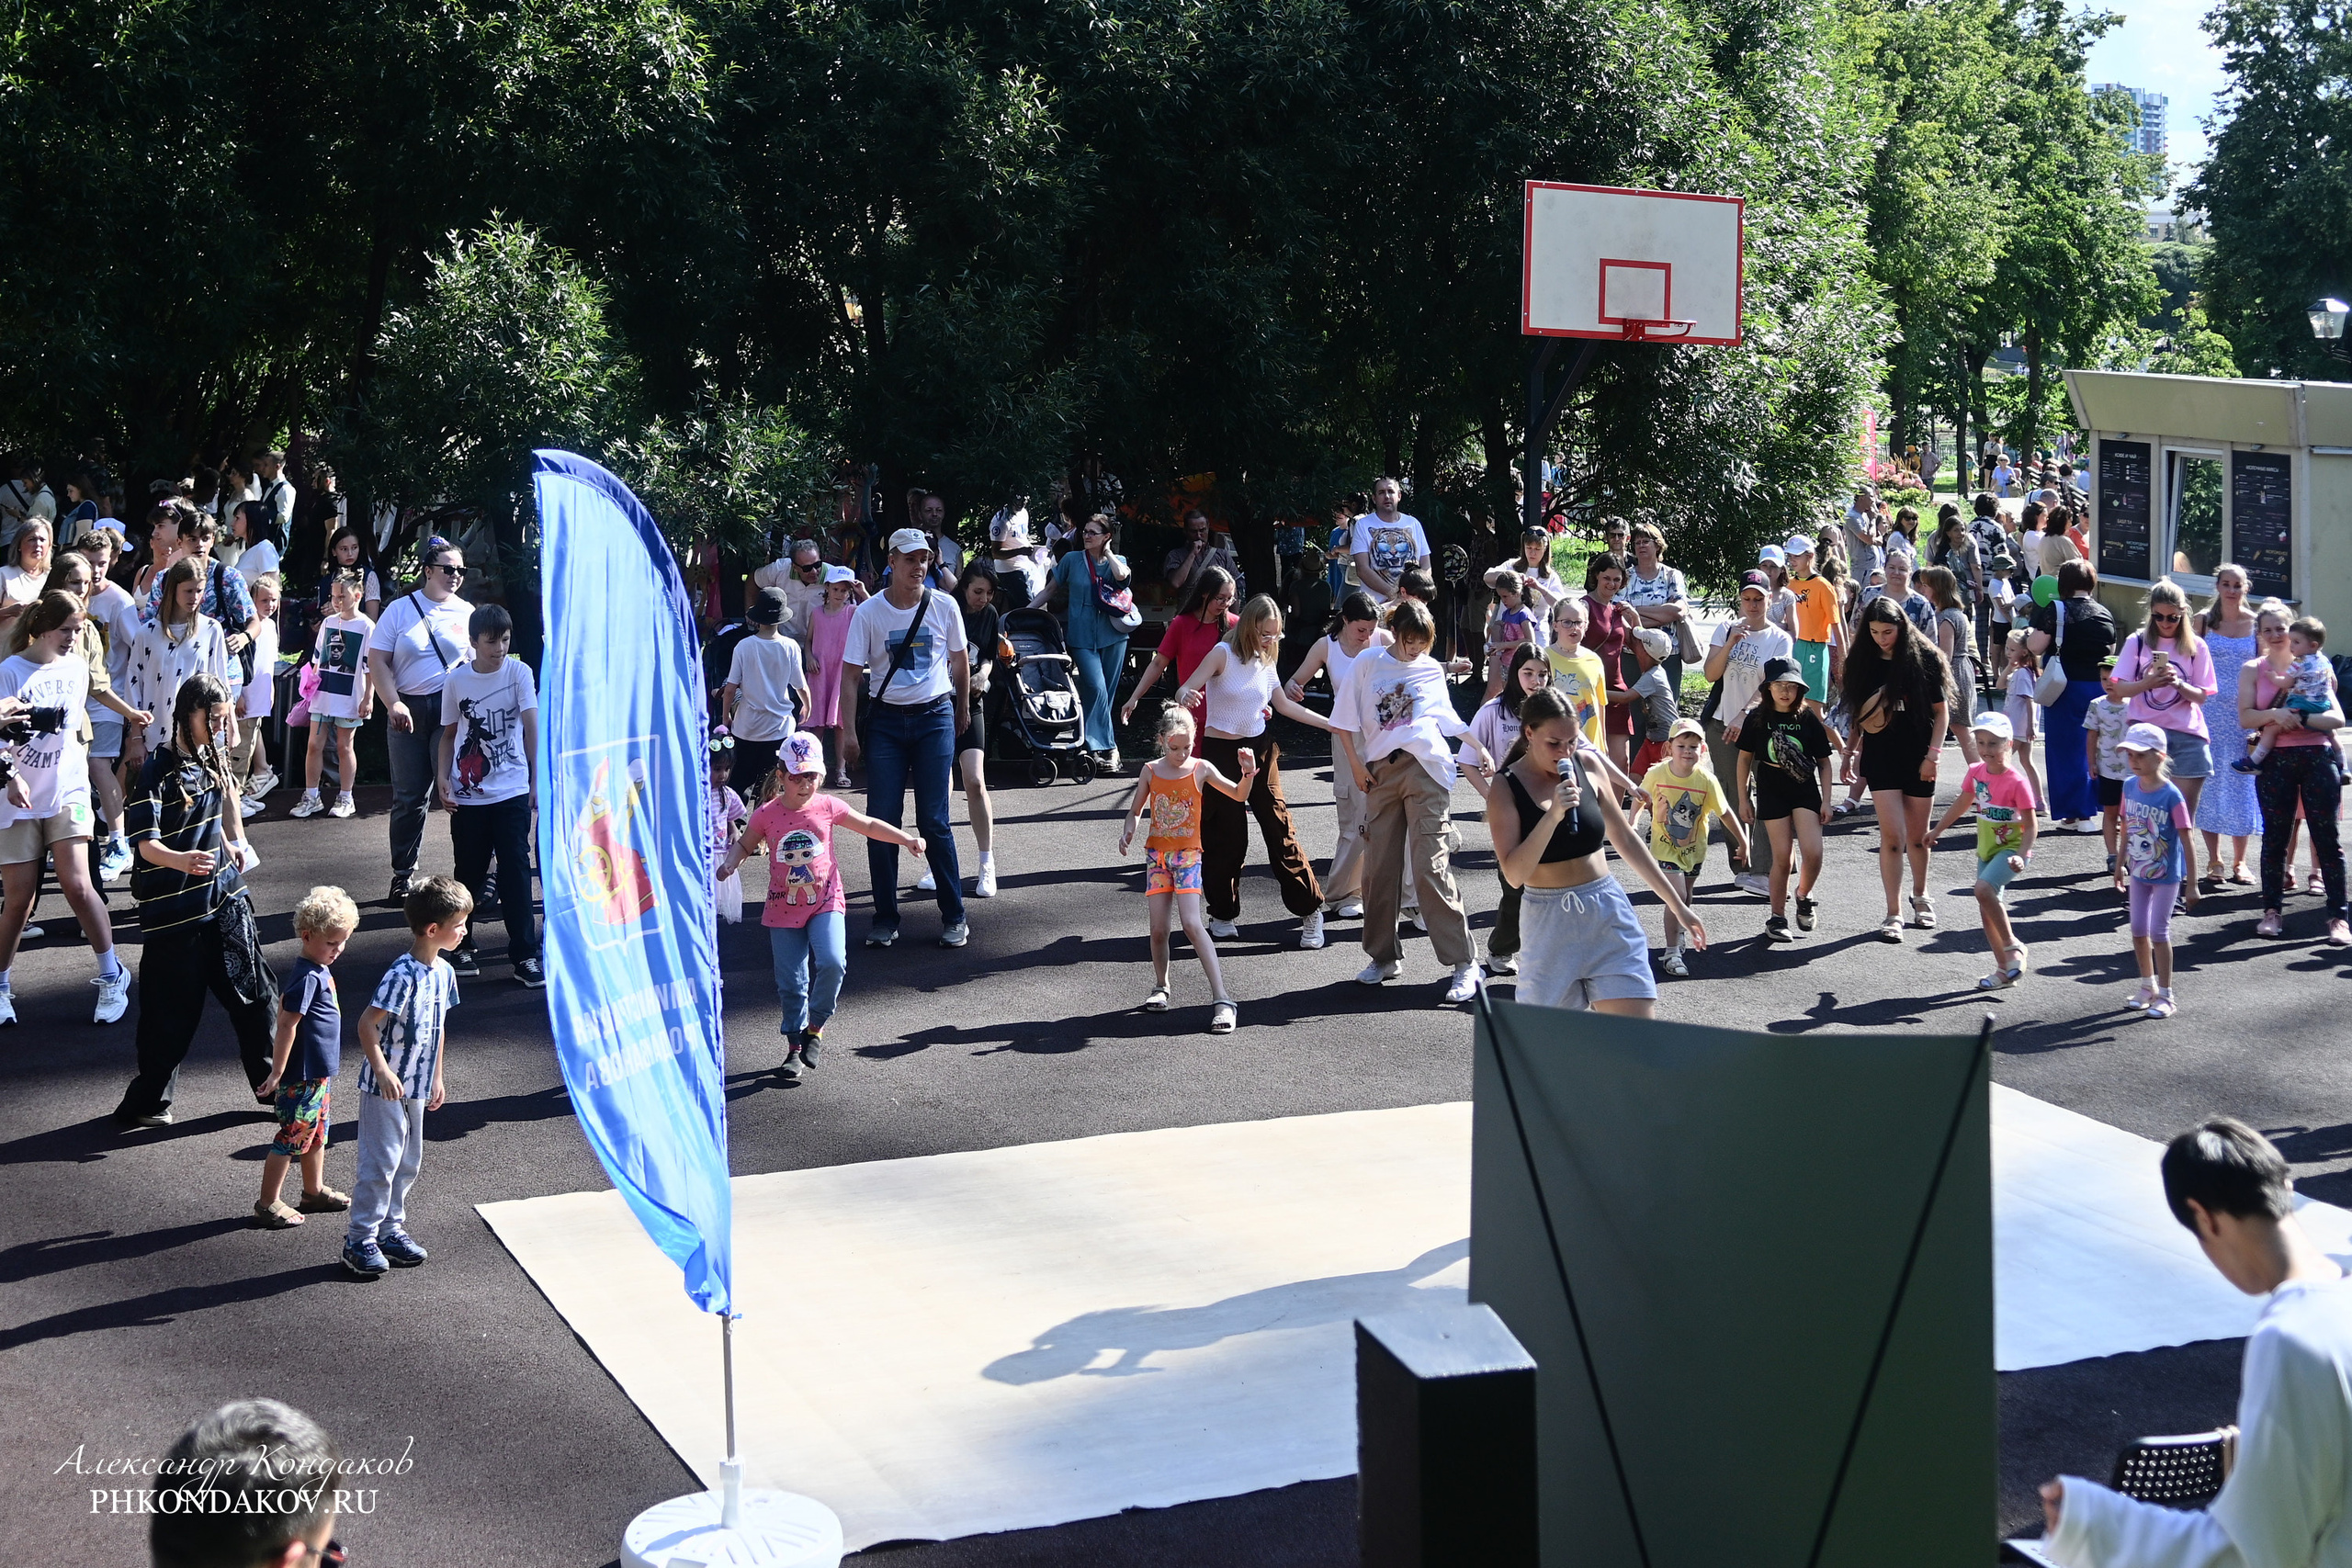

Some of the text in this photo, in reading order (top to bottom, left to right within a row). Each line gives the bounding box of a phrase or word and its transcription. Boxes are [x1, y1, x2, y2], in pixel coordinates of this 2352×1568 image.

[1735, 641, 1758, 655] LET'S
[1730, 649, 1761, 666] SCAPE
[17, 743, 63, 769] CHAMP
[1986, 807, 2015, 821] JERRY
[1680, 845, 1697, 858] HOPE
[768, 889, 786, 901] STAR
